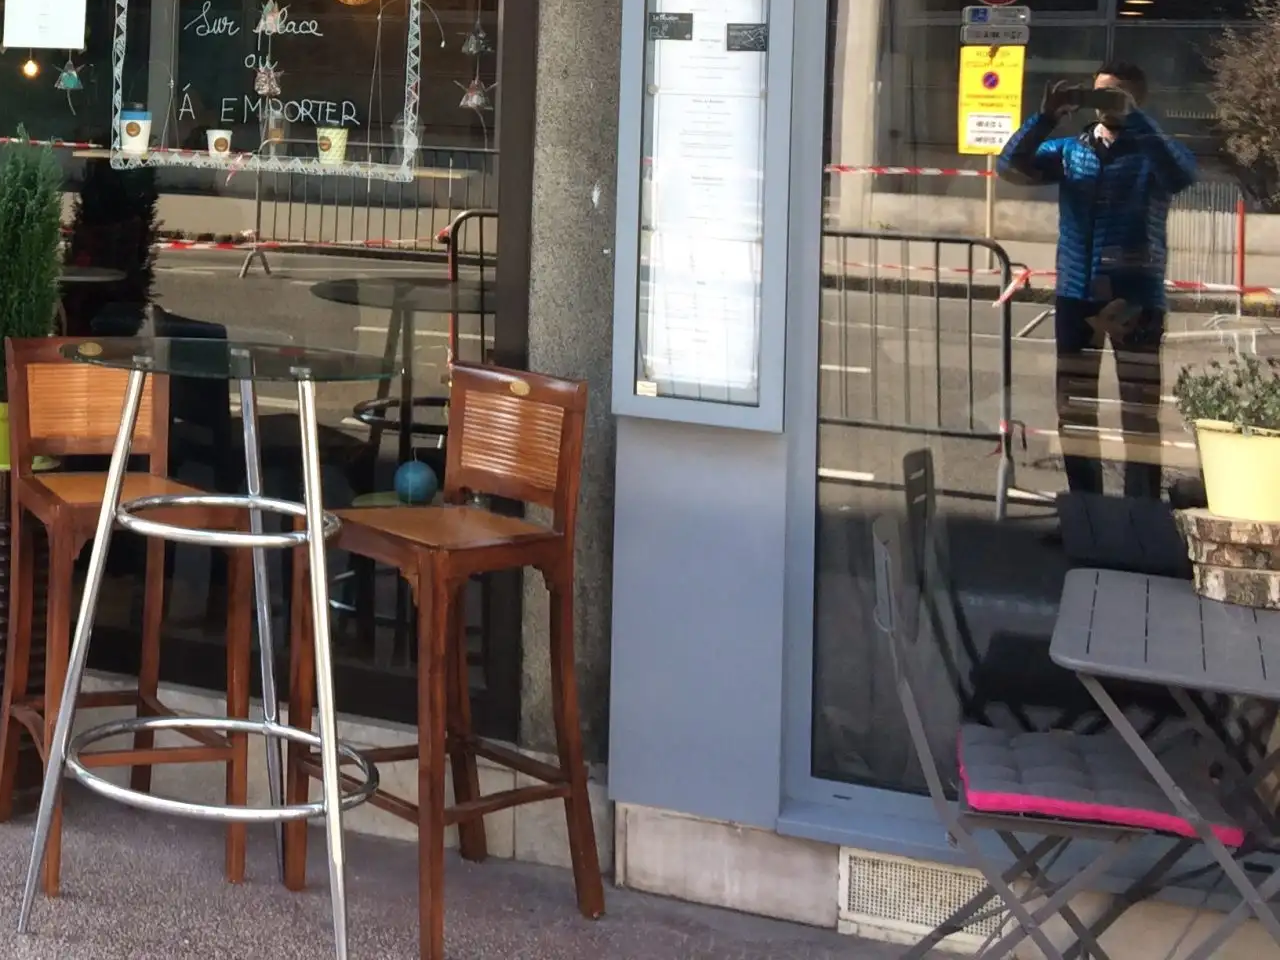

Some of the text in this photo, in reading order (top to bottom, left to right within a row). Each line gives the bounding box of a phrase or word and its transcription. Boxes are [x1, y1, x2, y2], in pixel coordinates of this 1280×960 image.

[183, 0, 324, 52] Sur place
[244, 53, 279, 70] ou
[220, 94, 361, 126] EMPORTER
